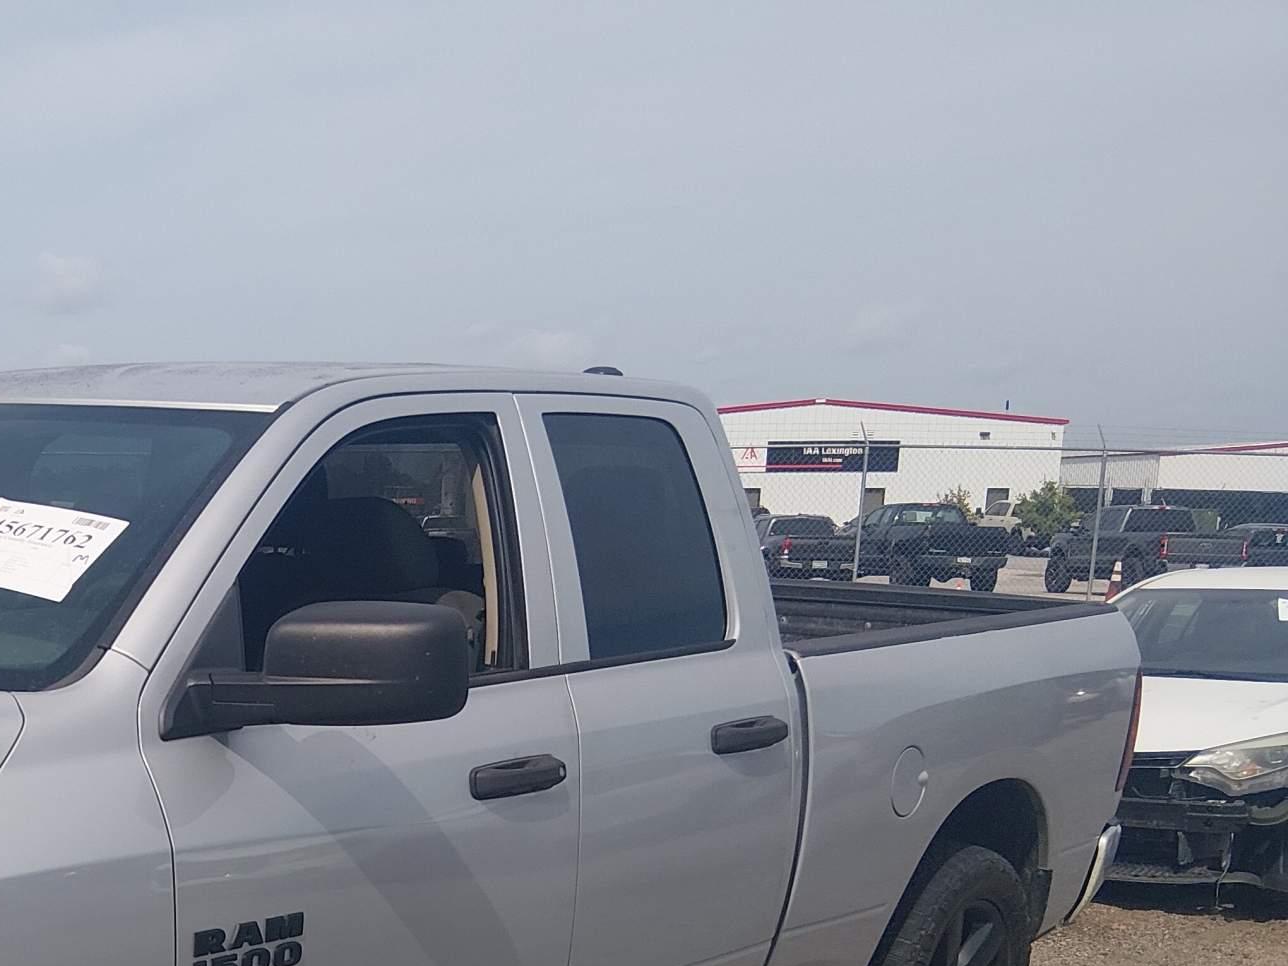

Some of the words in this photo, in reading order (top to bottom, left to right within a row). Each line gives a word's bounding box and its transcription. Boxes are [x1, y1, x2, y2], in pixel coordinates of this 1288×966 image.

[803, 447, 819, 455] IAA
[821, 447, 863, 457] Lexington
[193, 911, 304, 958] RAM
